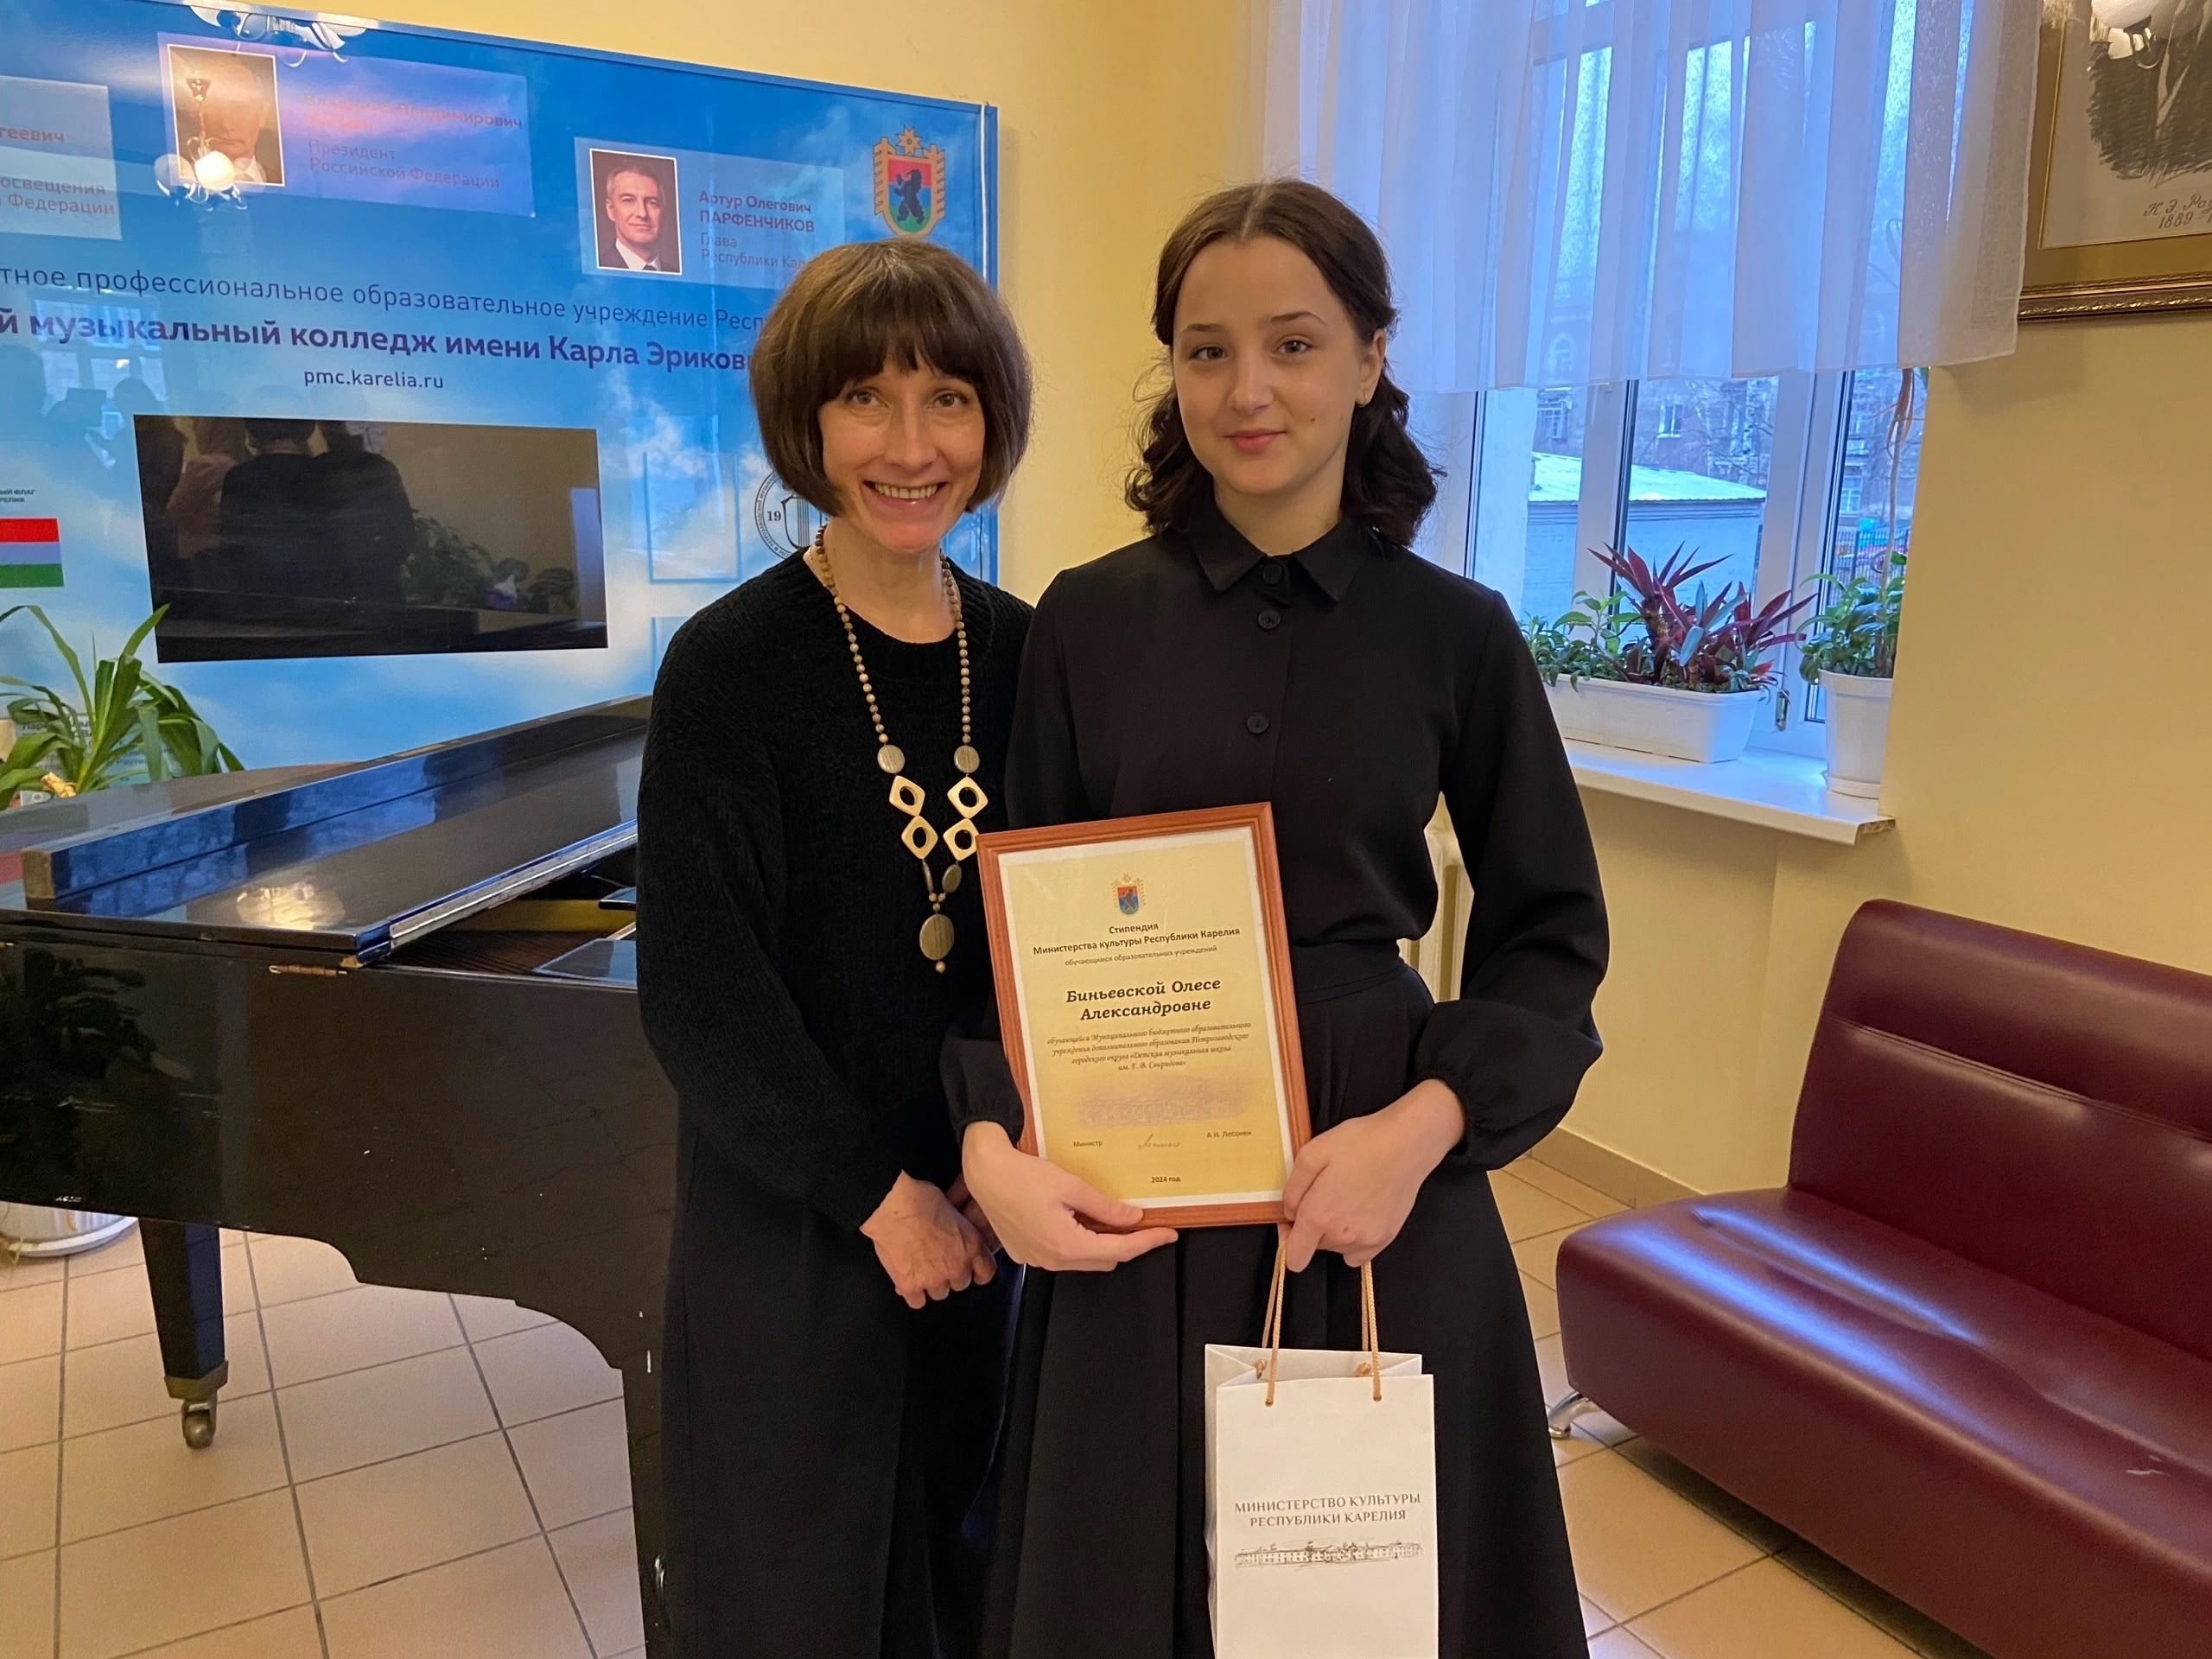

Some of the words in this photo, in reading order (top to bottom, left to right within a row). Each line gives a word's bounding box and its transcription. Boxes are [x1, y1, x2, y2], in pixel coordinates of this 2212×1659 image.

[309, 140, 396, 160] Президент
[311, 157, 405, 180] Российской
[410, 167, 499, 188] Федерации
[1, 177, 105, 194] освещения
[8, 194, 115, 214] Федерации
[699, 191, 742, 209] Артур
[746, 195, 811, 213] Олегович
[699, 210, 815, 232] ПАРФЕНЧИКОВ
[700, 232, 737, 248] Глава
[0, 268, 66, 287] тное
[77, 269, 344, 302] профессиональное
[353, 283, 566, 318] образовательное
[573, 302, 708, 327] учреждение
[30, 315, 281, 346] музыкальный
[290, 327, 437, 356] колледж
[446, 335, 540, 359] имени
[549, 334, 639, 369] Карла
[303, 369, 444, 389] pmc.karelia.ru
[767, 511, 782, 522] 19
[1109, 923, 1159, 934] Стипендия
[1033, 942, 1097, 955] Министерства
[1099, 938, 1141, 950] культуры
[1144, 932, 1198, 944] Республики
[1200, 928, 1240, 939] Карелия
[1114, 950, 1173, 961] образовательных
[1174, 945, 1217, 957] учреждений
[1065, 981, 1166, 1003] Биньевской
[1172, 979, 1222, 994] Олесе
[1080, 1000, 1211, 1020] Александровне
[1235, 1497, 1345, 1513] МИНИСТЕРСТВО
[1350, 1492, 1421, 1507] КУЛЬТУРЫ
[1249, 1513, 1340, 1528] РЕСПУБЛИКИ
[1344, 1510, 1407, 1523] КАРЕЛИЯ
